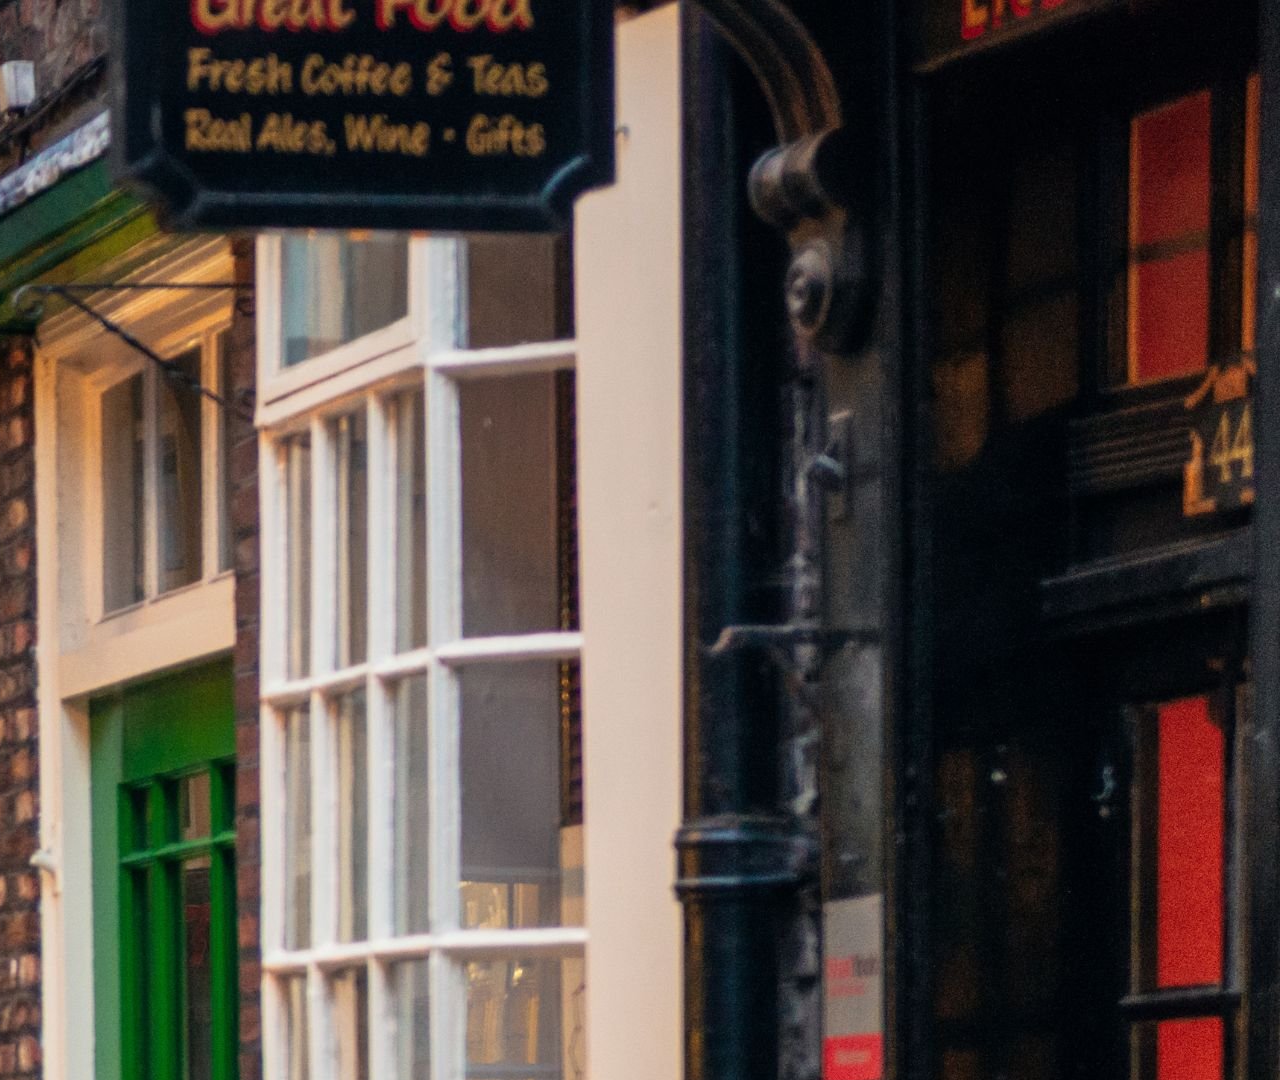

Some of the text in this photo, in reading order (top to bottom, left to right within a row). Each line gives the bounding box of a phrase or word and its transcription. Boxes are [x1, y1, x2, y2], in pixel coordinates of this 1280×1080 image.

[186, 46, 549, 97] Fresh Coffee & Teas
[184, 108, 252, 153] Real
[344, 112, 430, 157] Wine
[465, 112, 547, 157] Gifts
[1209, 403, 1254, 484] 44
